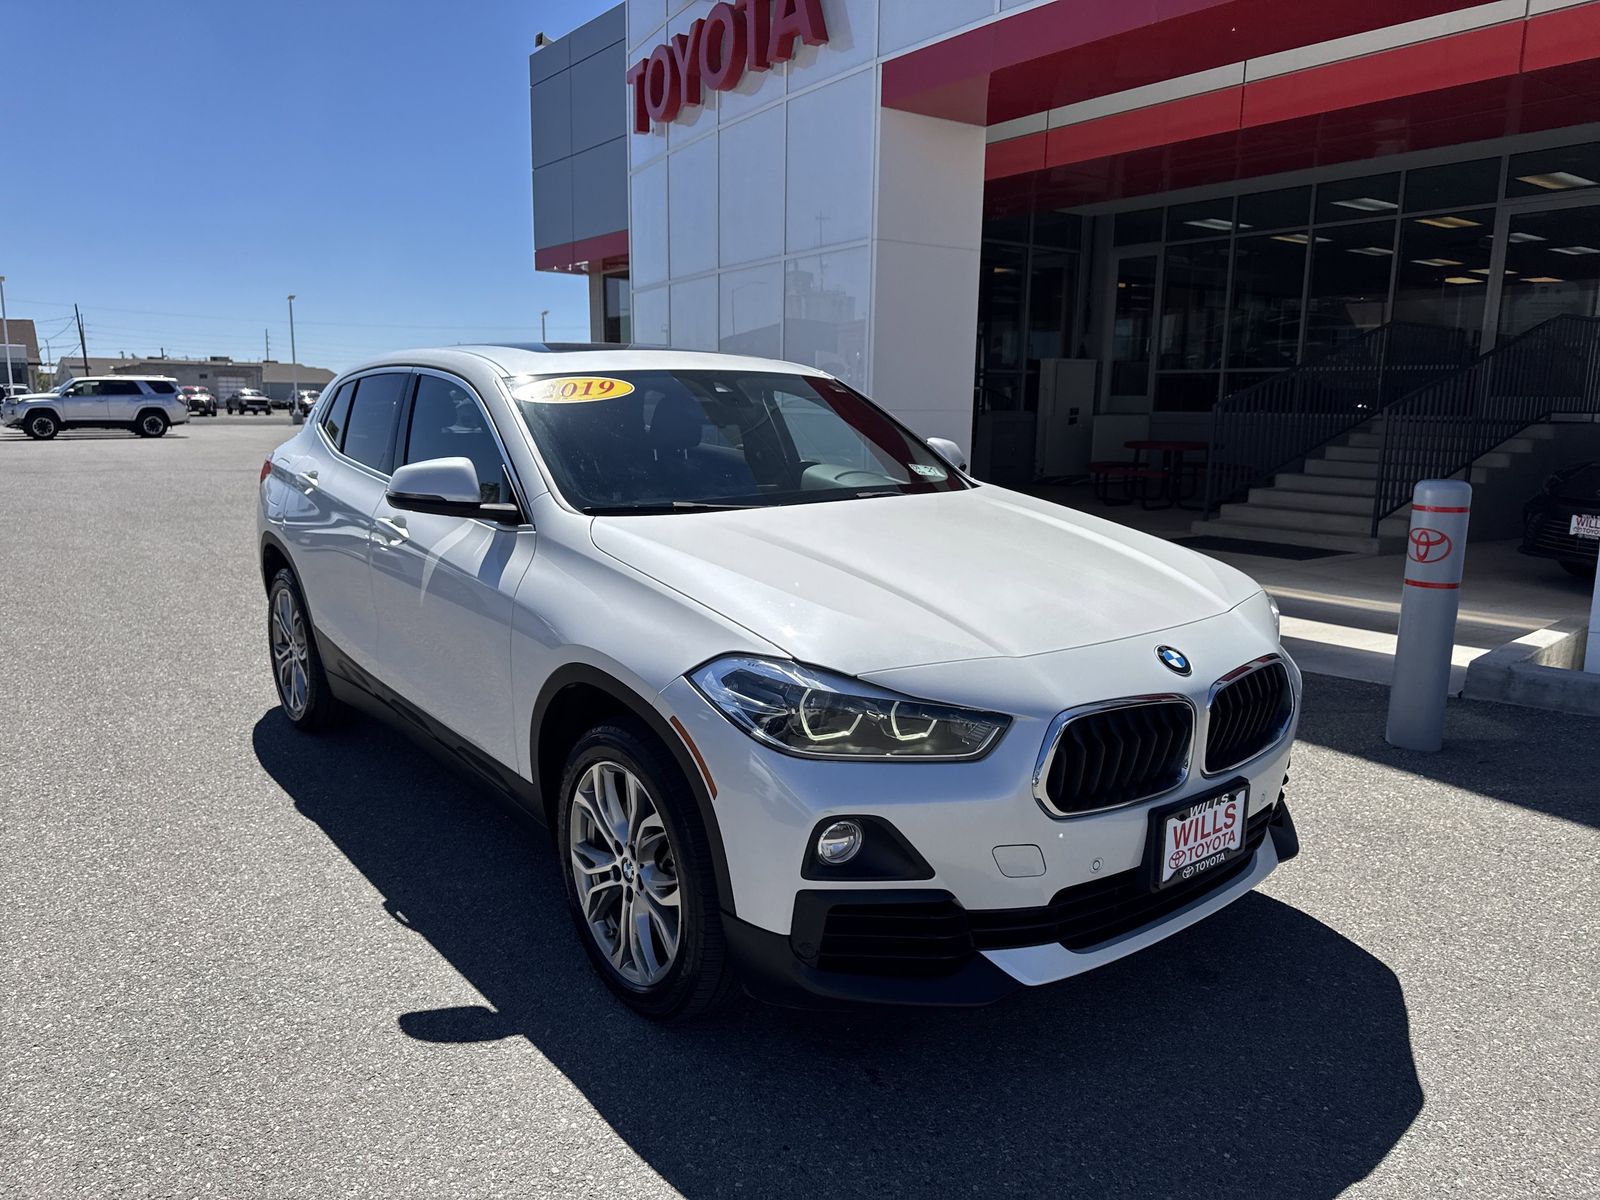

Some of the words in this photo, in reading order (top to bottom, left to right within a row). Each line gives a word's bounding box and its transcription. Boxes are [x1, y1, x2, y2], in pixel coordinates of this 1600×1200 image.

[627, 0, 829, 135] TOYOTA
[1190, 794, 1229, 817] WILLS
[1173, 803, 1237, 849] WILLS
[1188, 830, 1236, 861] TOYOTA
[1195, 853, 1225, 873] TOYOTA
